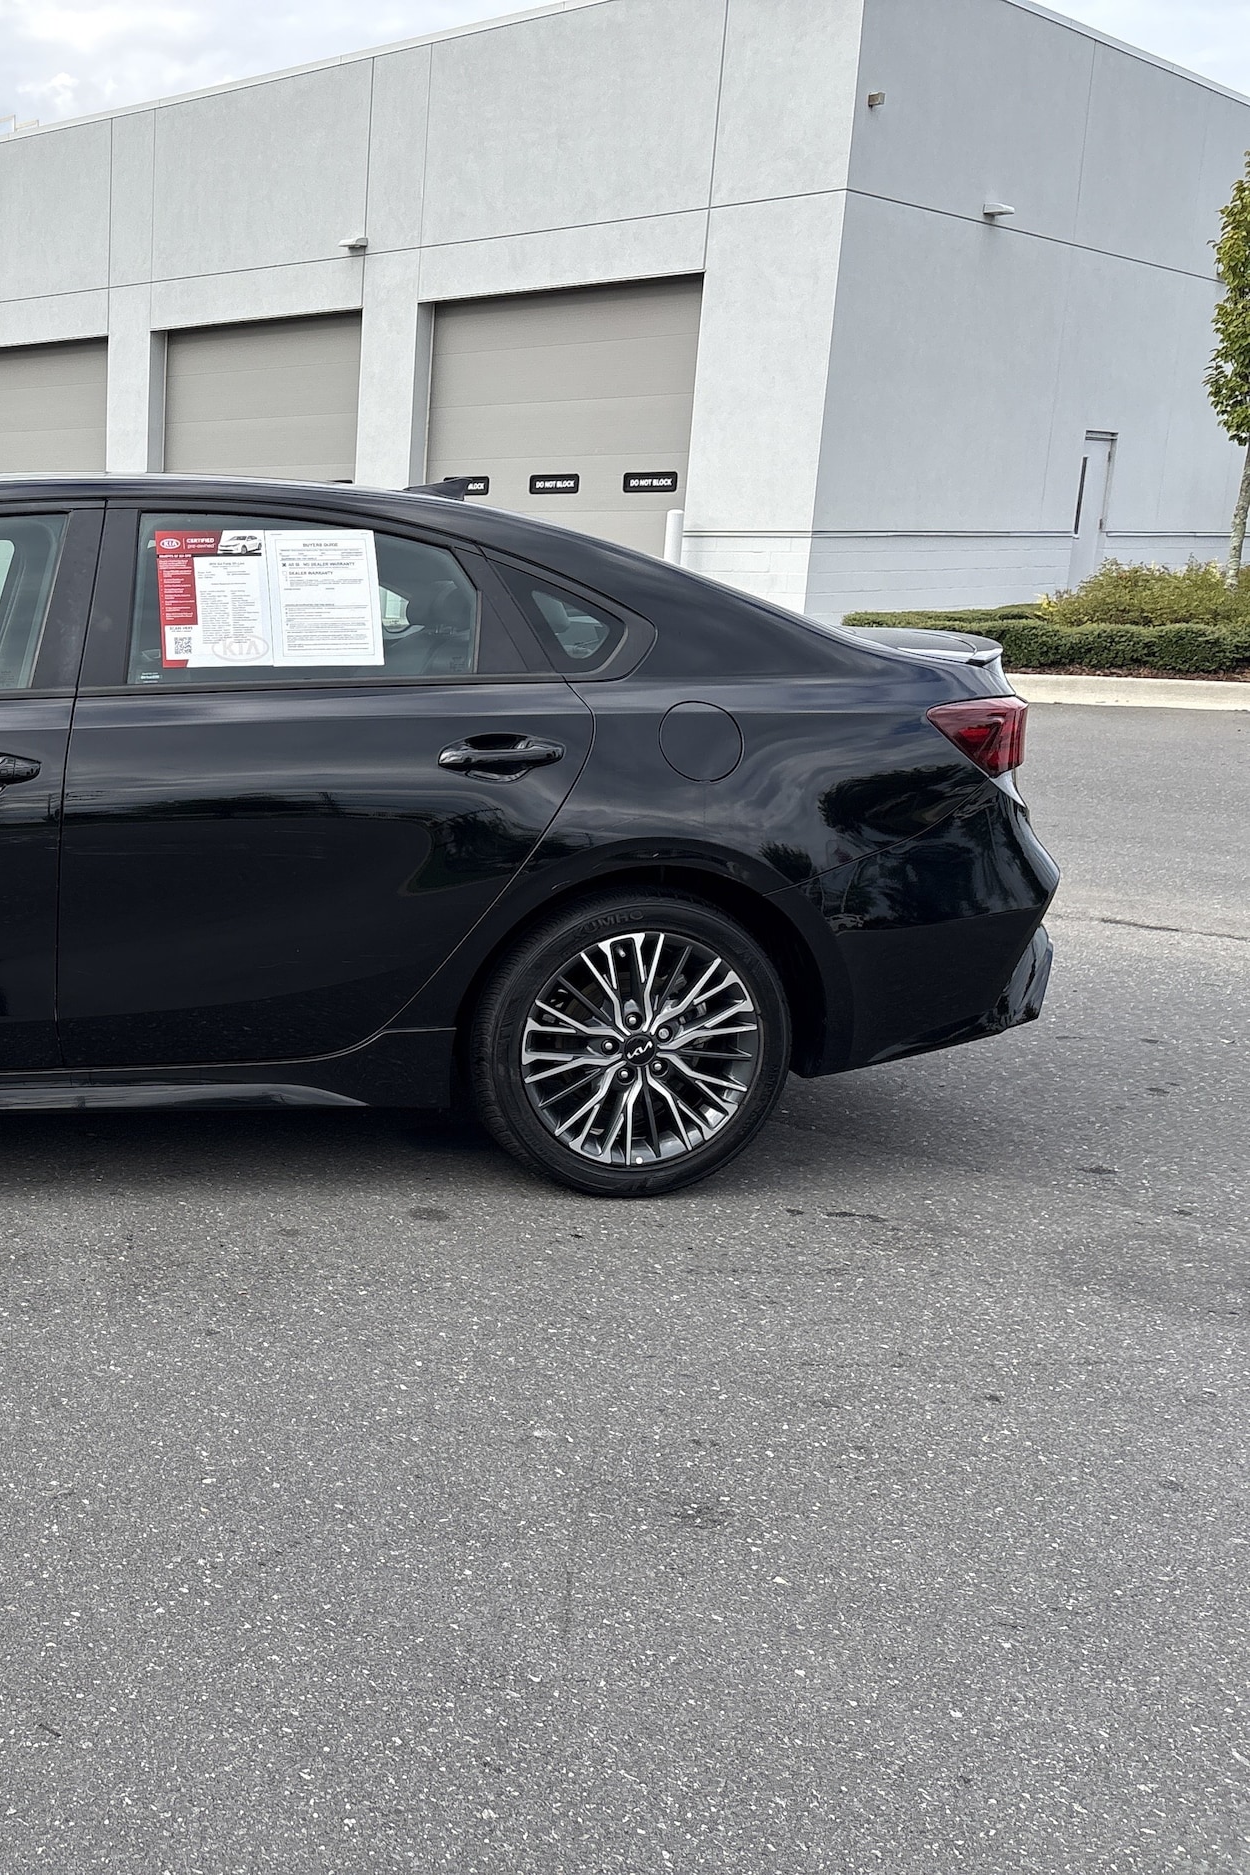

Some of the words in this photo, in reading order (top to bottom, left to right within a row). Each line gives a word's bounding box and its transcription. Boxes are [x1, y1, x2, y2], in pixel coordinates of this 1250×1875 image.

[557, 480, 575, 488] BLOCK
[630, 479, 639, 487] DO
[653, 478, 673, 486] BLOCK
[222, 639, 261, 656] KIA
[574, 910, 645, 938] KUMHO
